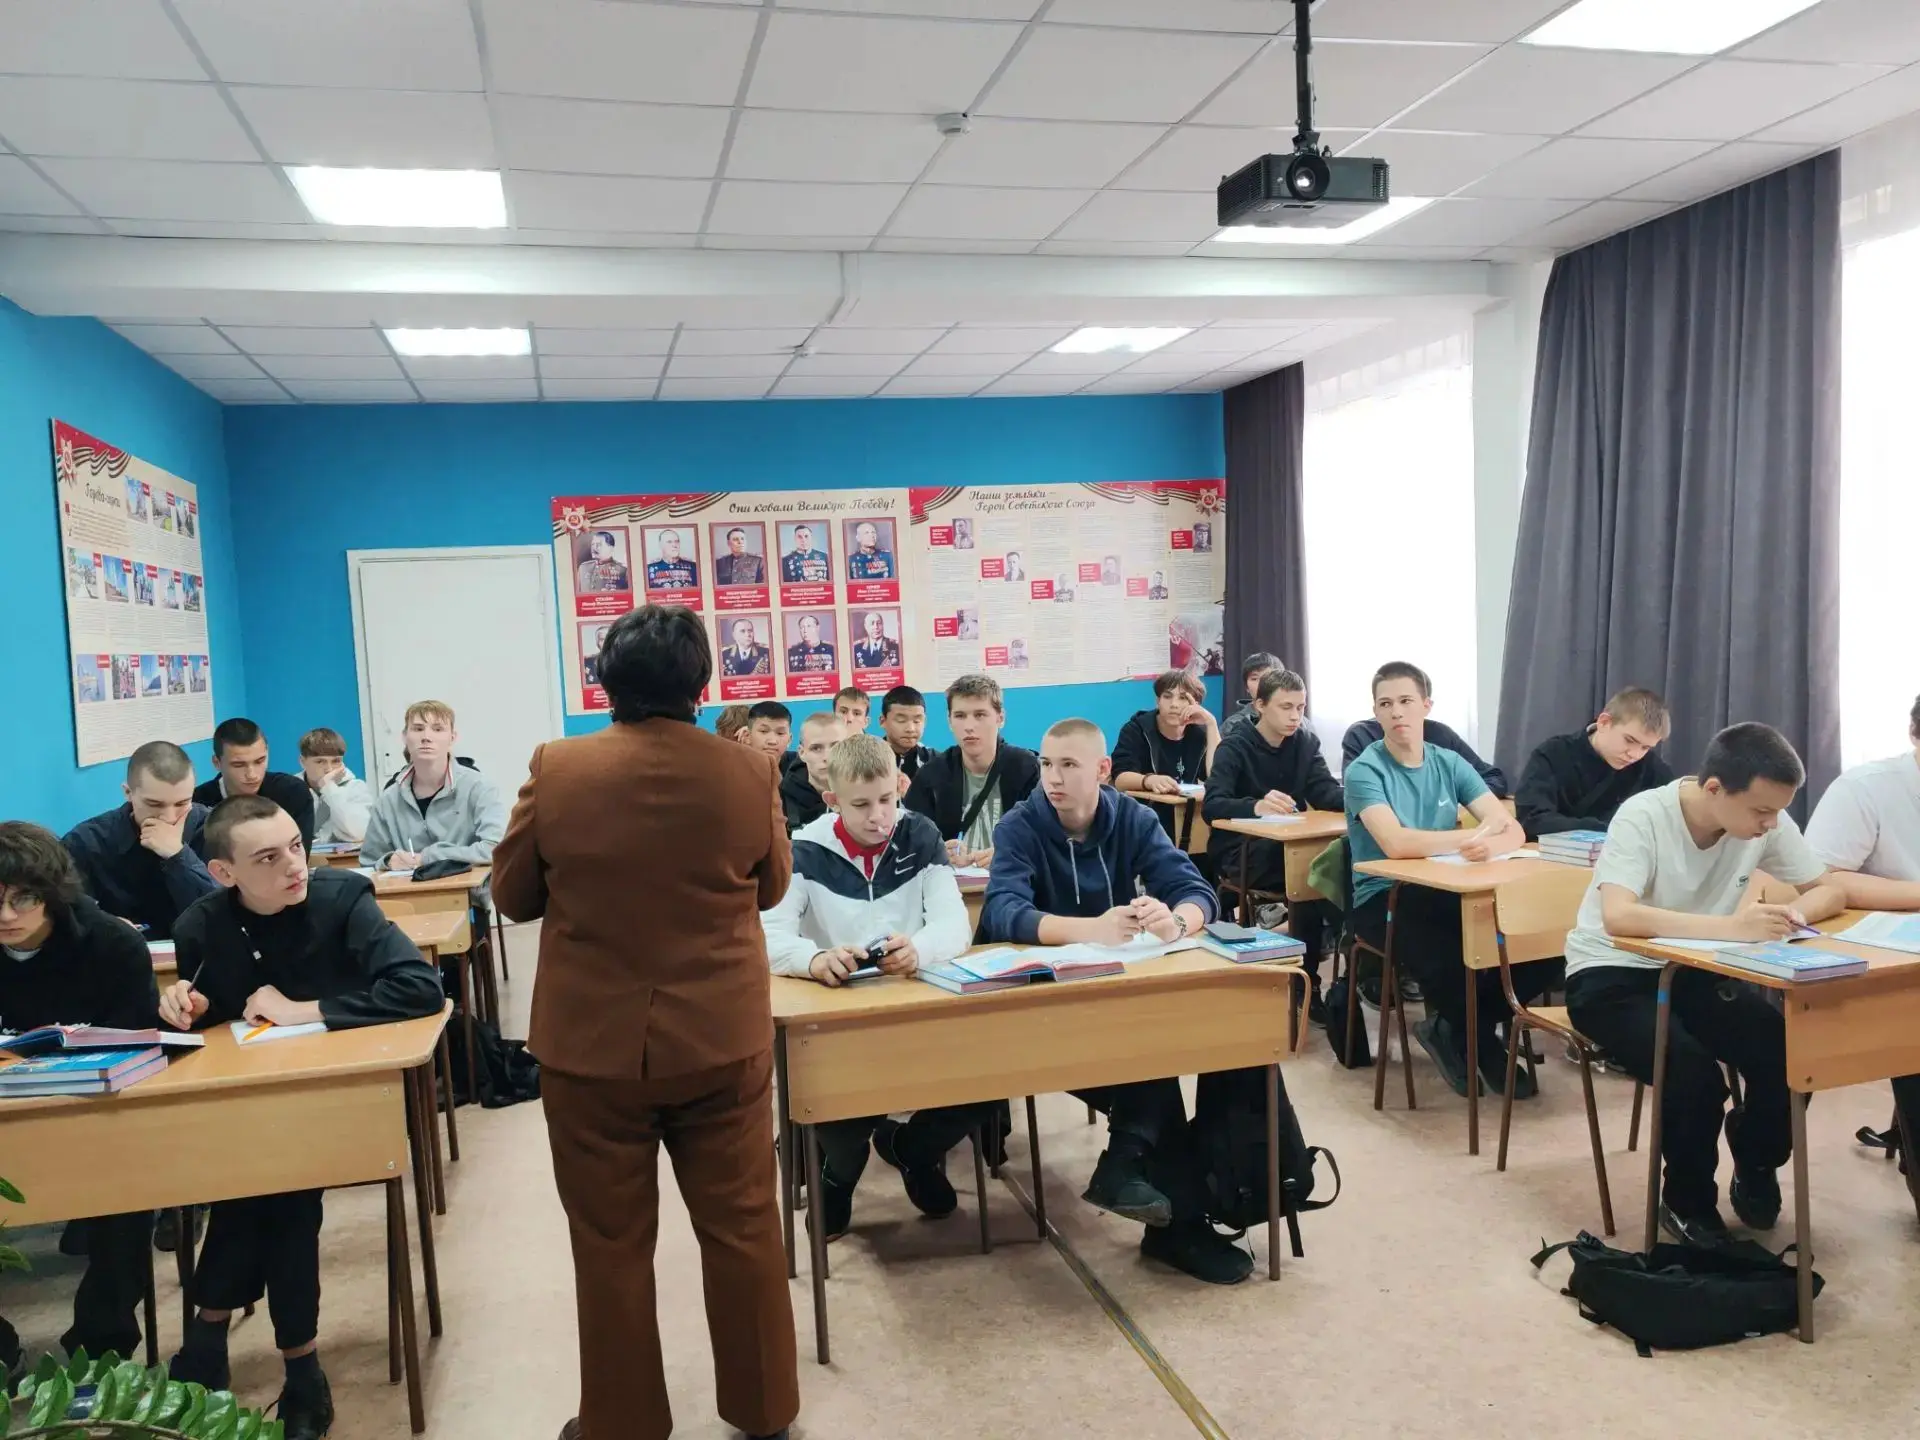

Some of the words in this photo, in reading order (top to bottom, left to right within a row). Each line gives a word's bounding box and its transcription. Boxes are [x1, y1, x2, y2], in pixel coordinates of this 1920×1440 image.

[969, 490, 1000, 500] Наши
[1004, 489, 1046, 502] земляки
[728, 502, 750, 513] Они
[754, 500, 793, 512] ковали
[797, 500, 845, 513] Великую
[849, 498, 895, 512] Победу!
[975, 501, 1005, 513] Герои
[1008, 499, 1063, 509] Советского
[1066, 499, 1096, 510] Союза
